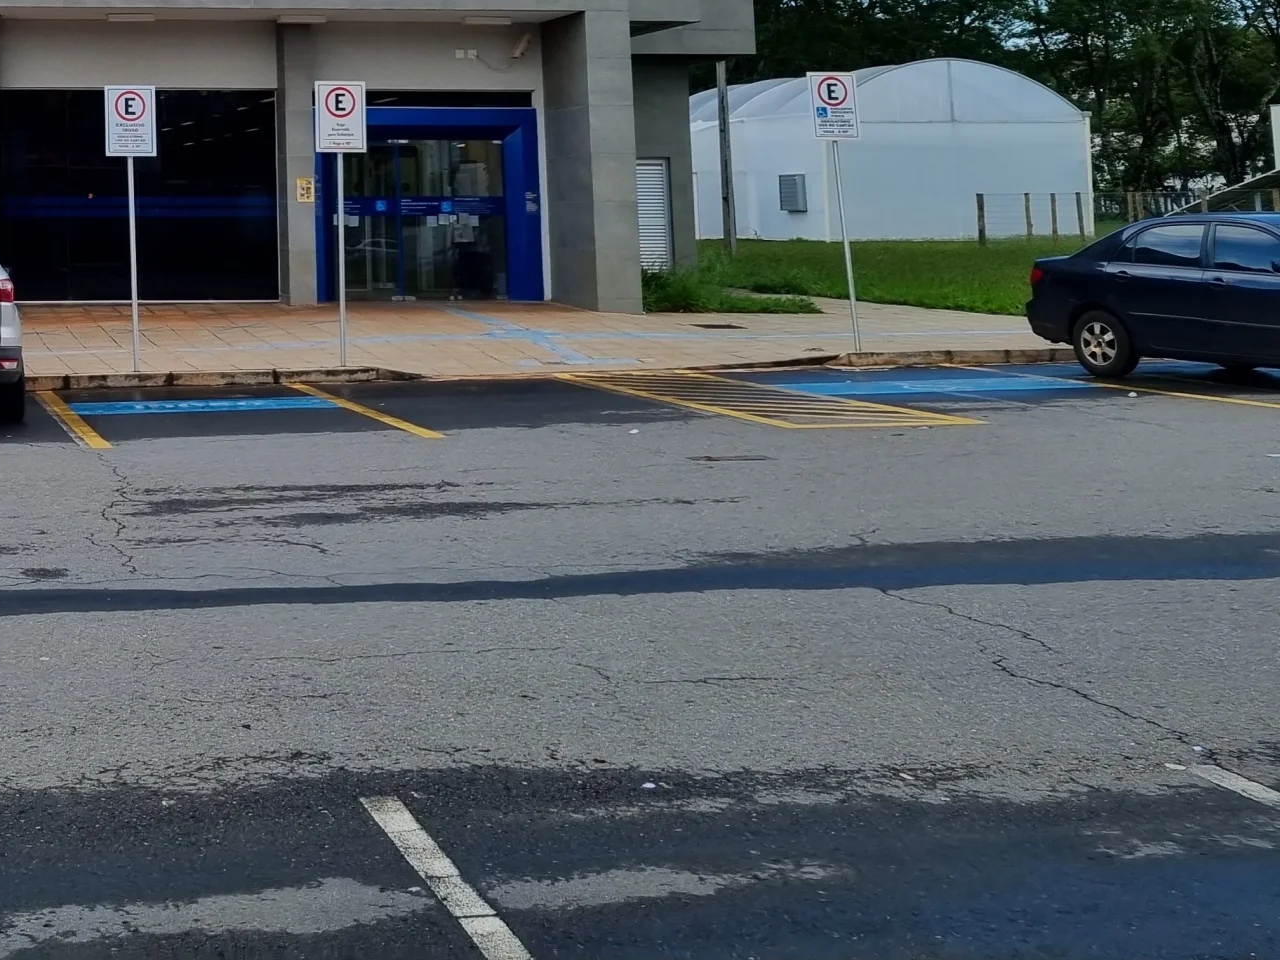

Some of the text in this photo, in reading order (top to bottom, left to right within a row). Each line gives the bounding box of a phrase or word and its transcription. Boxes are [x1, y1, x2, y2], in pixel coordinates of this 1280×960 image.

[826, 83, 839, 100] E
[125, 98, 136, 115] E
[335, 93, 346, 111] E
